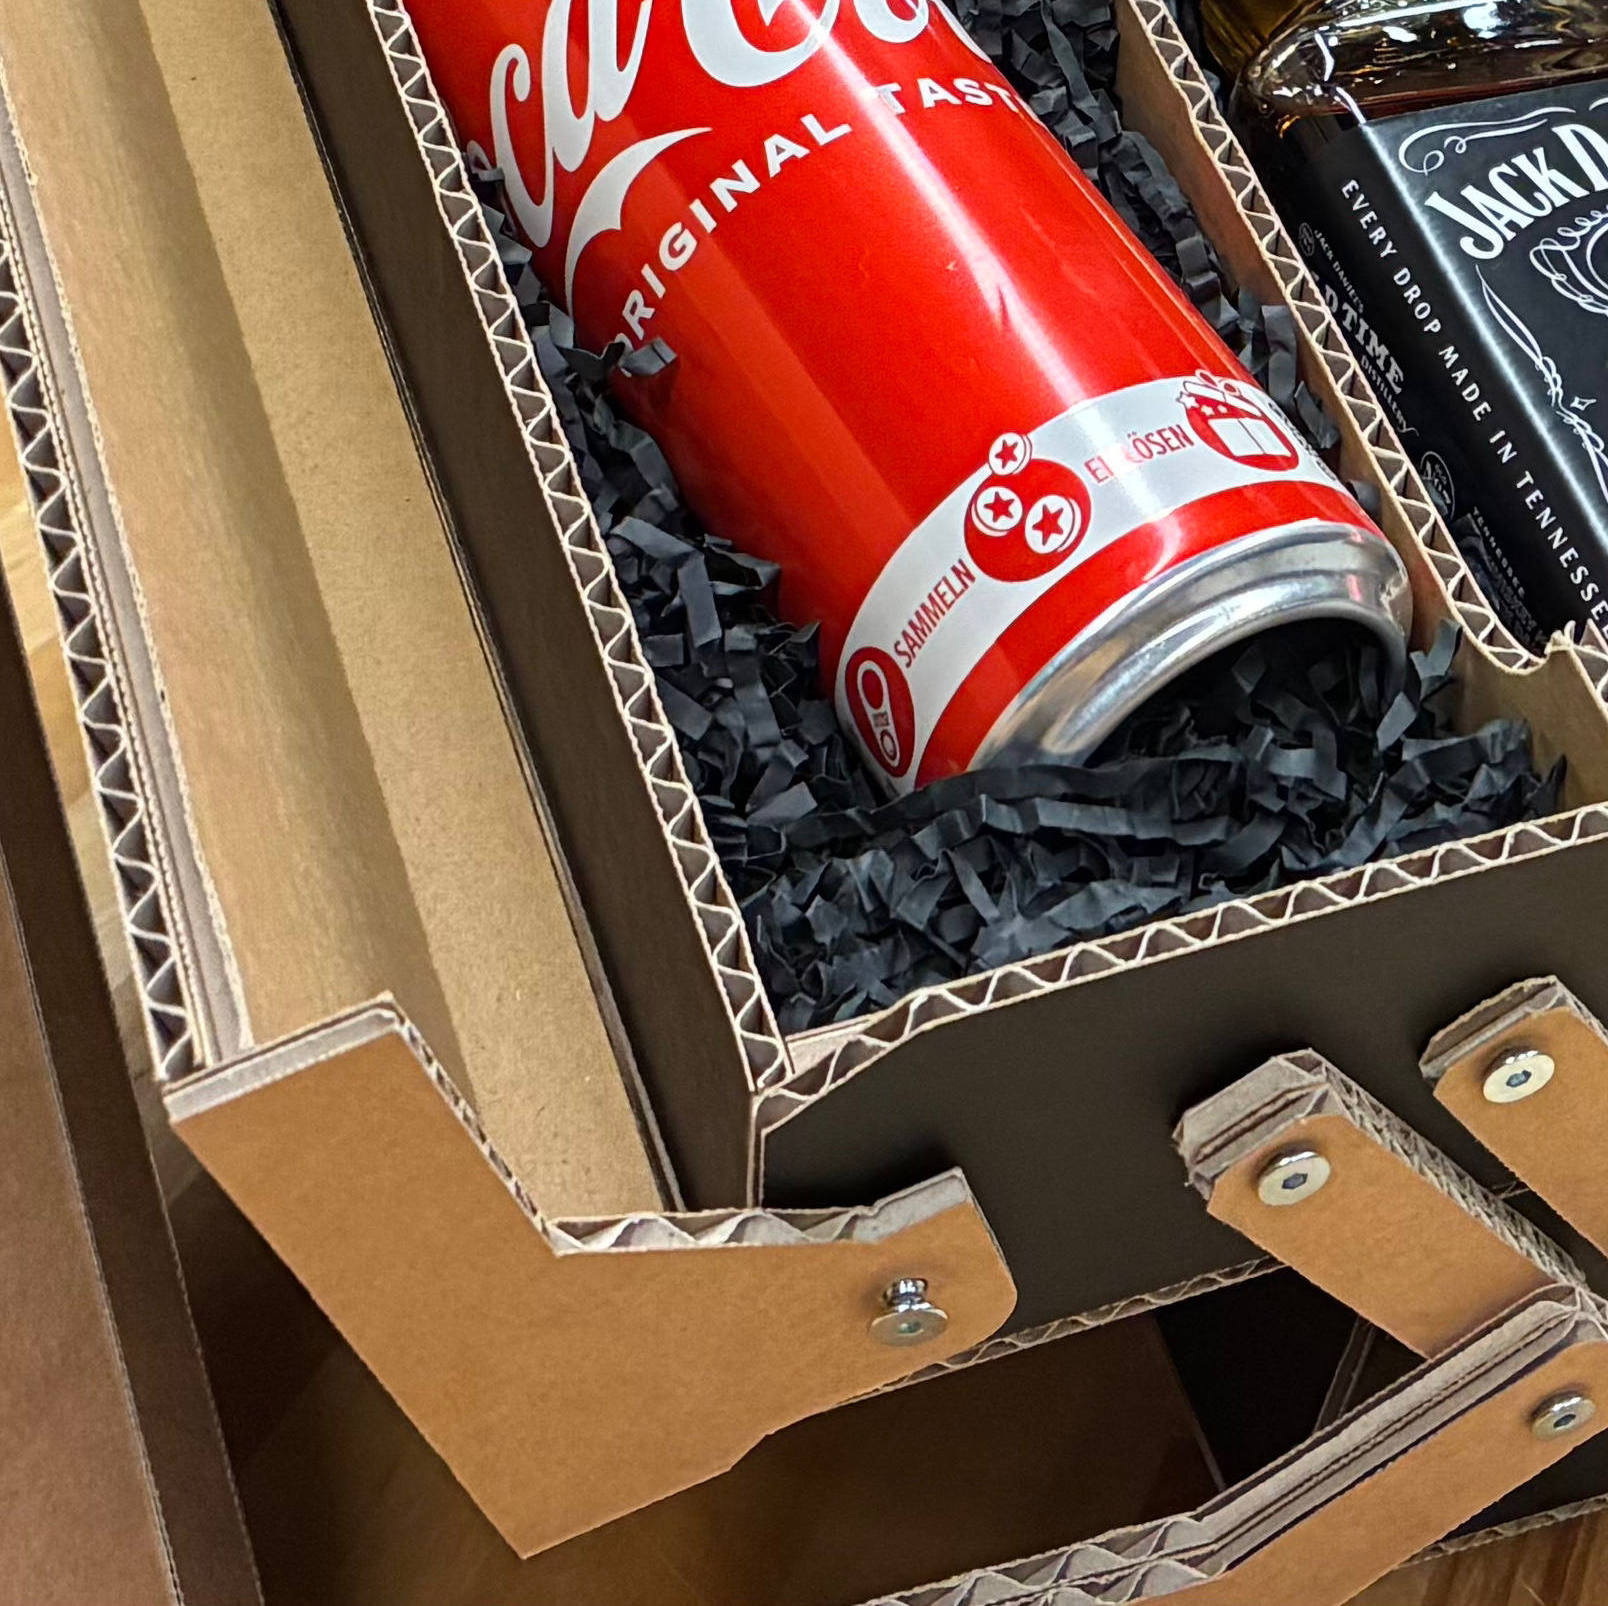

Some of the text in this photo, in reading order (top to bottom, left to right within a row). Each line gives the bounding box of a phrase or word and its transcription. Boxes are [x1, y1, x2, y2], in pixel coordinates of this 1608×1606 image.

[876, 77, 1043, 126] TAST
[1424, 146, 1590, 261] JACK
[1341, 179, 1399, 260] EVERY
[1393, 266, 1443, 337] DROP
[1437, 345, 1493, 424] MADE
[1488, 429, 1519, 467] IN
[1341, 302, 1405, 395] TIME
[893, 557, 976, 669] SAMMELN
